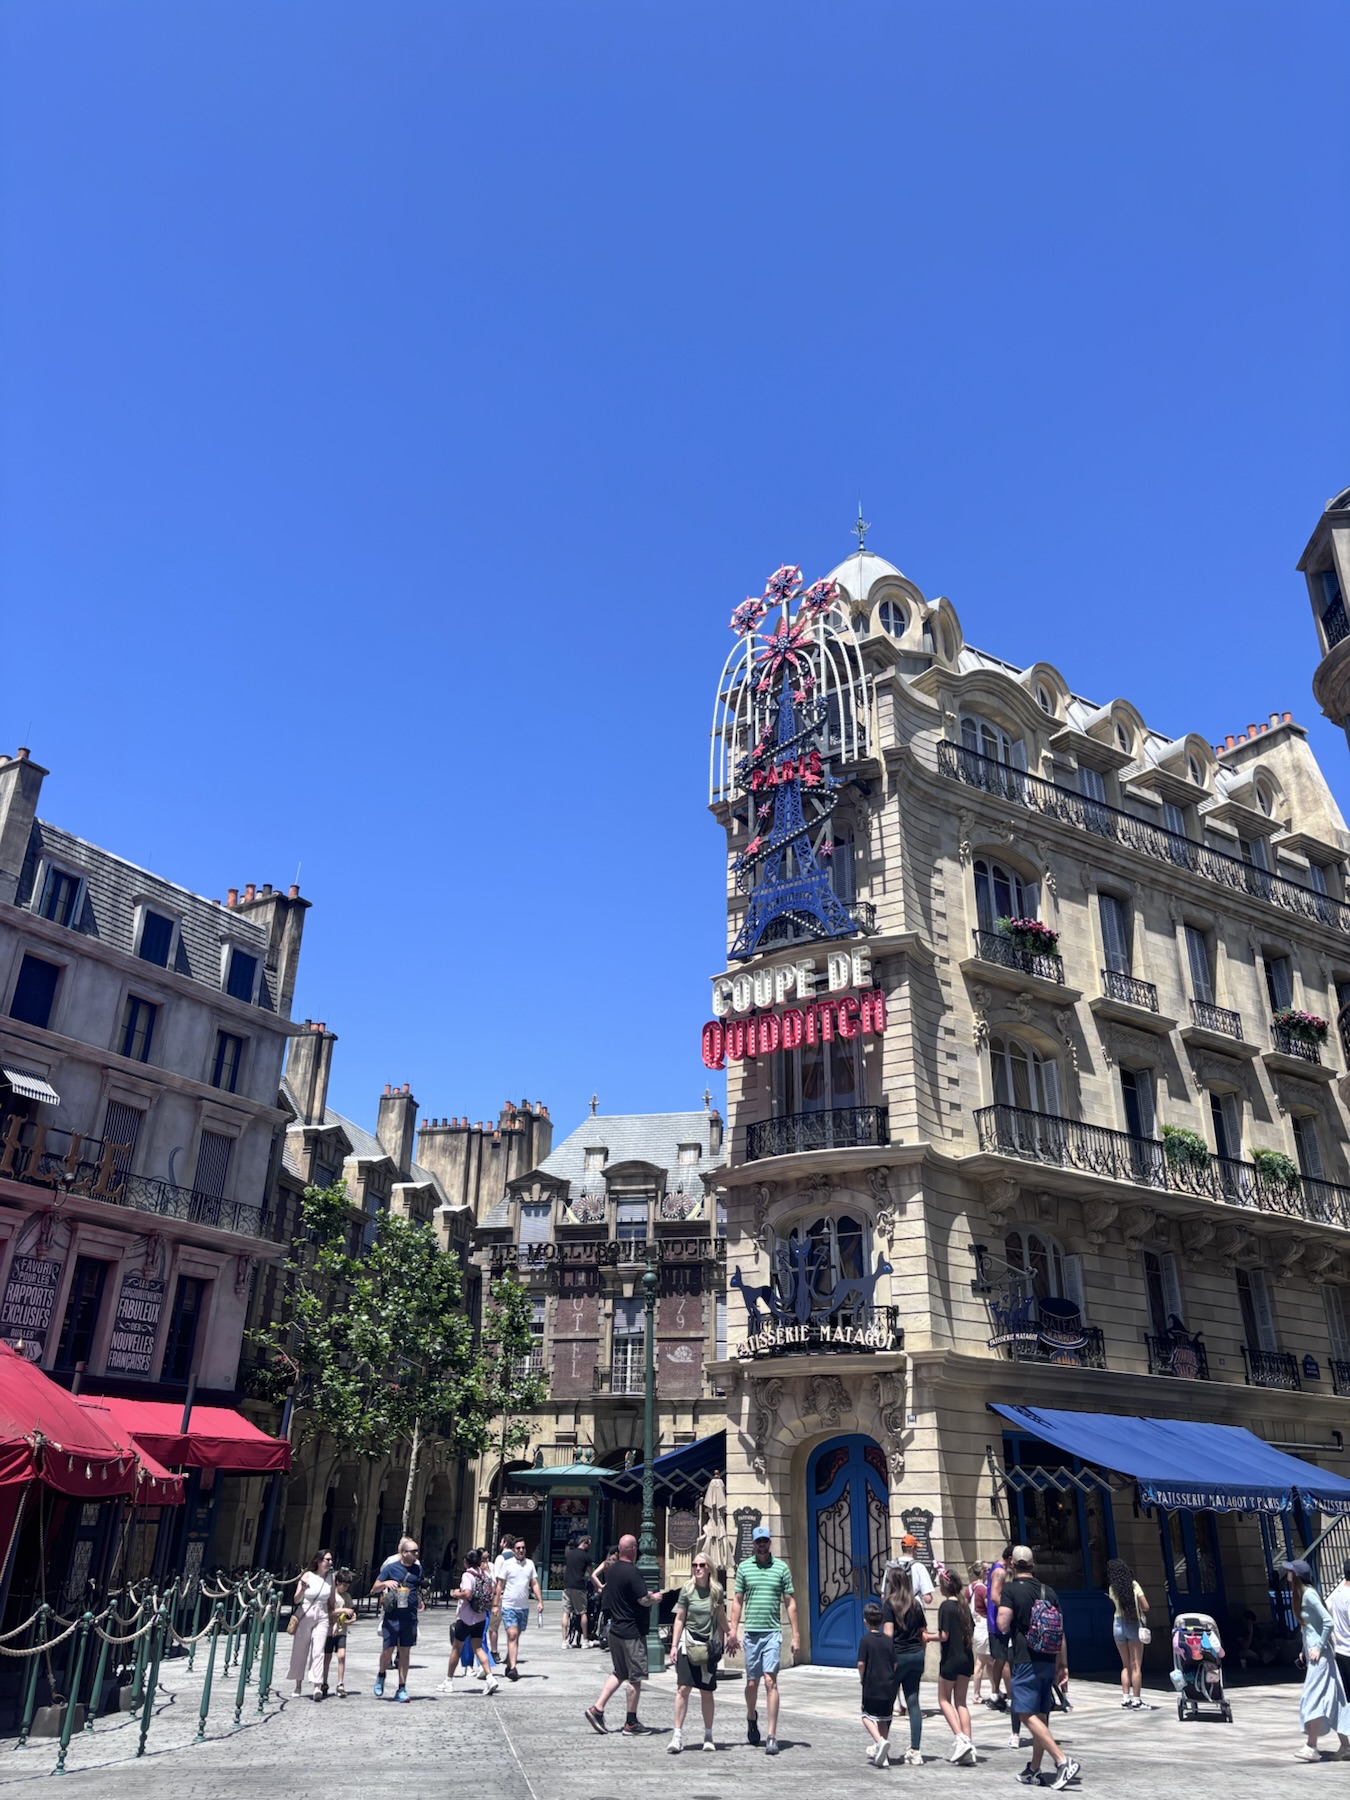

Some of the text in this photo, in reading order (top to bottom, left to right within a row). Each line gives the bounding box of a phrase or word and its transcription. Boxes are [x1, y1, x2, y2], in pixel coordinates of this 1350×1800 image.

[751, 751, 822, 791] PARIS
[712, 945, 873, 1018] COUPE DE
[701, 989, 887, 1070] QUIDDITCH
[18, 1271, 51, 1285] POUR LES
[20, 1258, 53, 1275] FAVORI
[5, 1282, 55, 1309] RAPPORTS
[138, 1279, 150, 1289] LES
[1, 1302, 51, 1328] EXCLUSIFS
[117, 1298, 160, 1323] FABULEUX
[22, 1329, 35, 1340] LES
[110, 1331, 155, 1354] NOUVELLES
[819, 1325, 896, 1350] MATAGOT
[107, 1350, 151, 1372] FRANÇAISES
[1156, 1490, 1280, 1510] PATISSERIE MATAGOT PARIS
